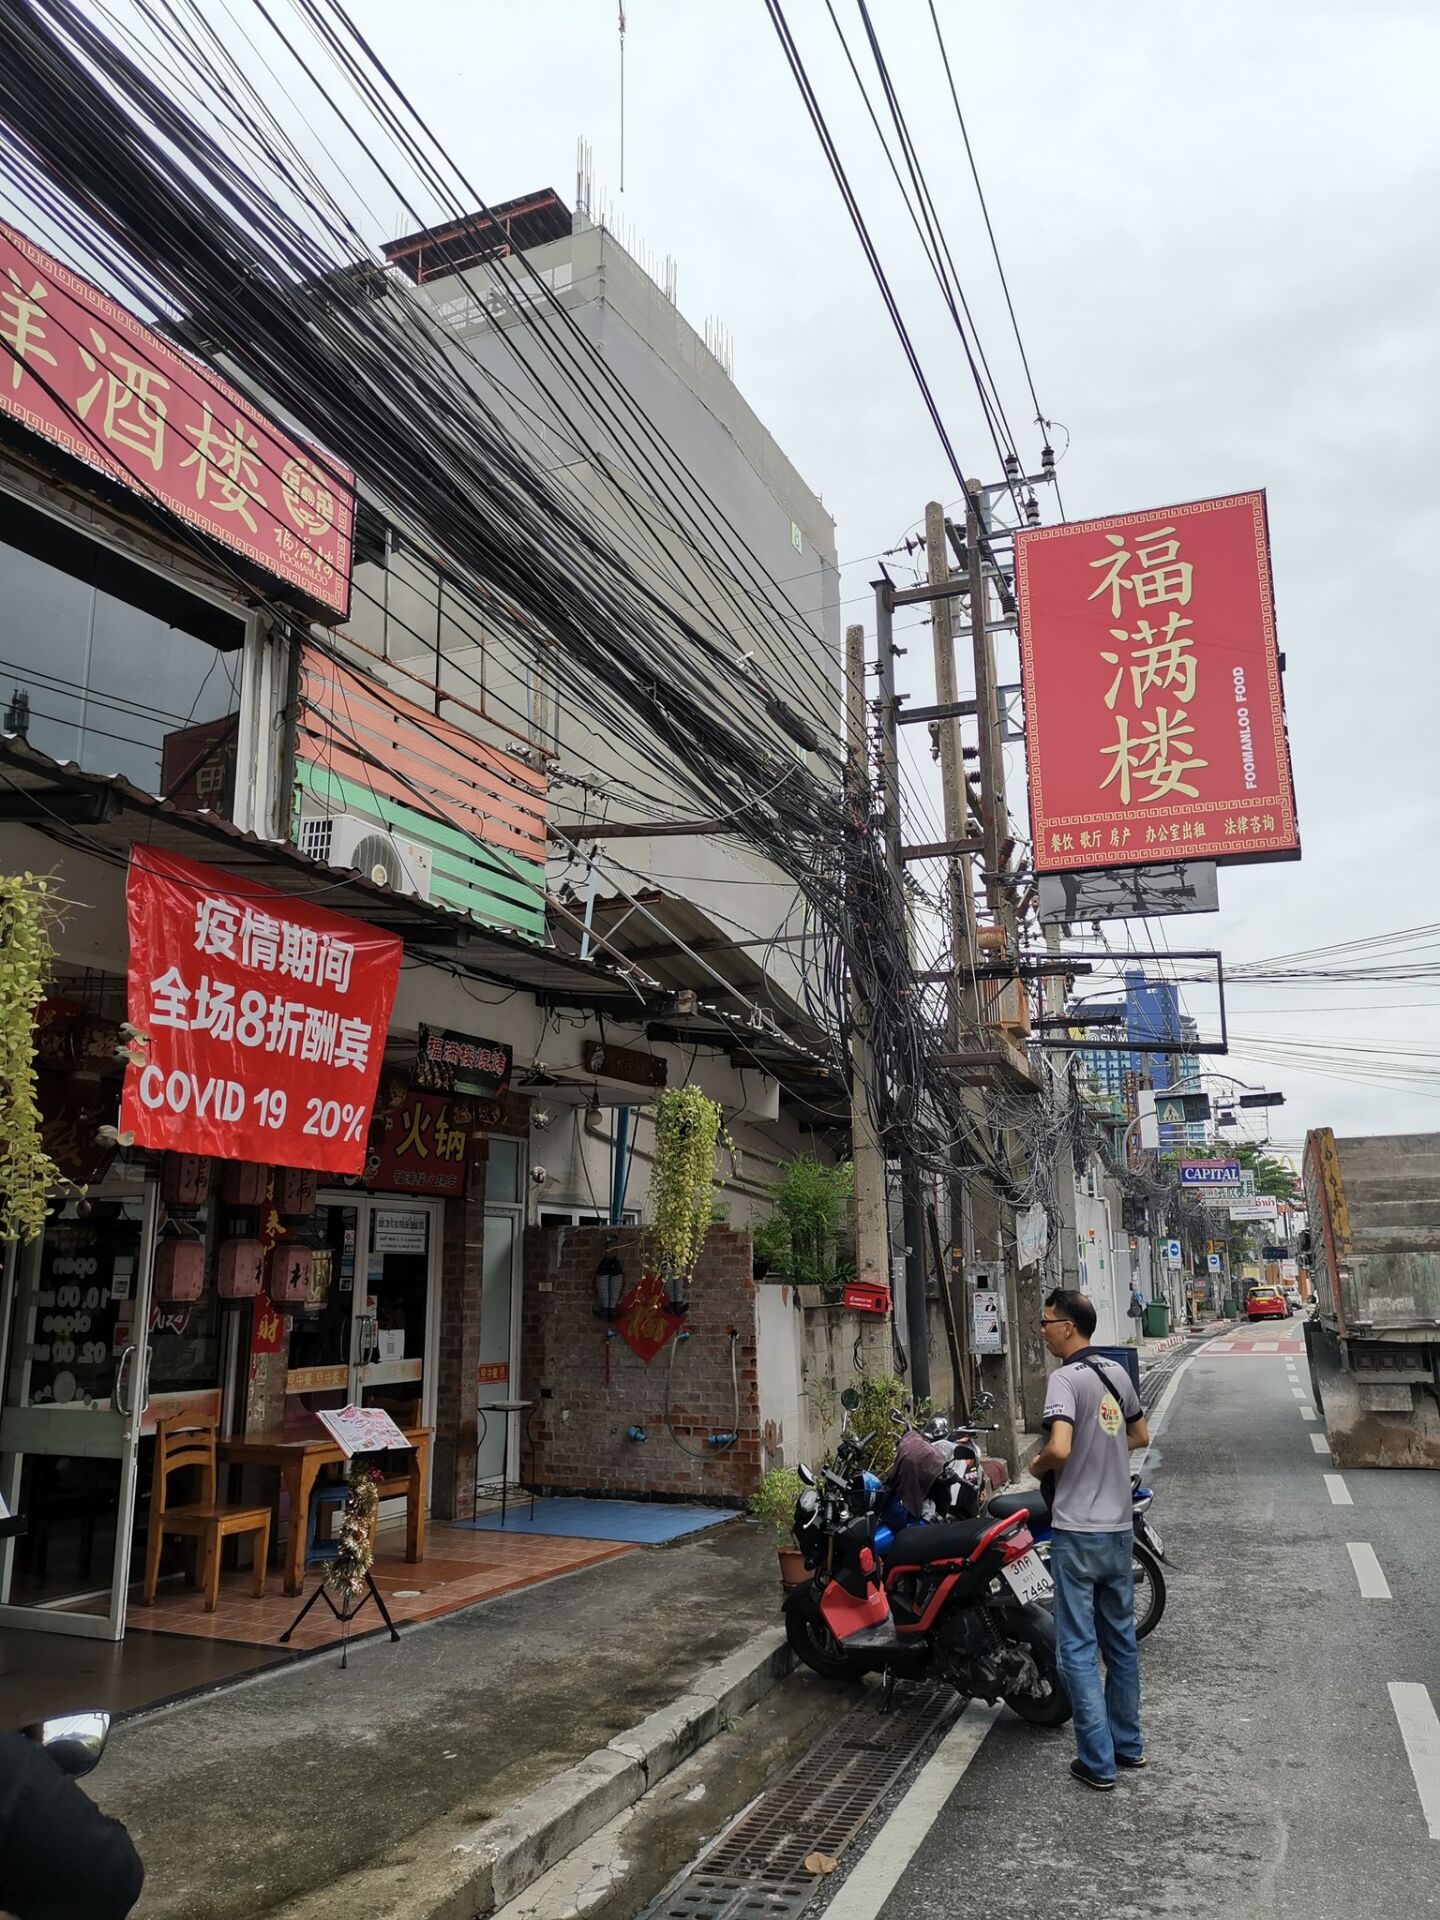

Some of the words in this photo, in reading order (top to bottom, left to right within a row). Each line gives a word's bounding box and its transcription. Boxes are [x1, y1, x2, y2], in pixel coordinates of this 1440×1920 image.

[1087, 526, 1209, 806] 福满楼
[1232, 666, 1247, 703] FOOD
[1237, 706, 1258, 790] FOOMANLOO
[1109, 826, 1133, 847] 房产
[1145, 821, 1207, 844] 办公室出租
[1224, 813, 1275, 836] 法律咨询
[193, 897, 354, 994] 疫情期间
[149, 966, 373, 1074] 全场8折酬宾
[139, 1064, 246, 1123] COVID
[253, 1087, 288, 1130] 19
[302, 1097, 366, 1143] 20%
[1184, 1168, 1239, 1180] CAPITAL
[1021, 1578, 1050, 1601] 7440
